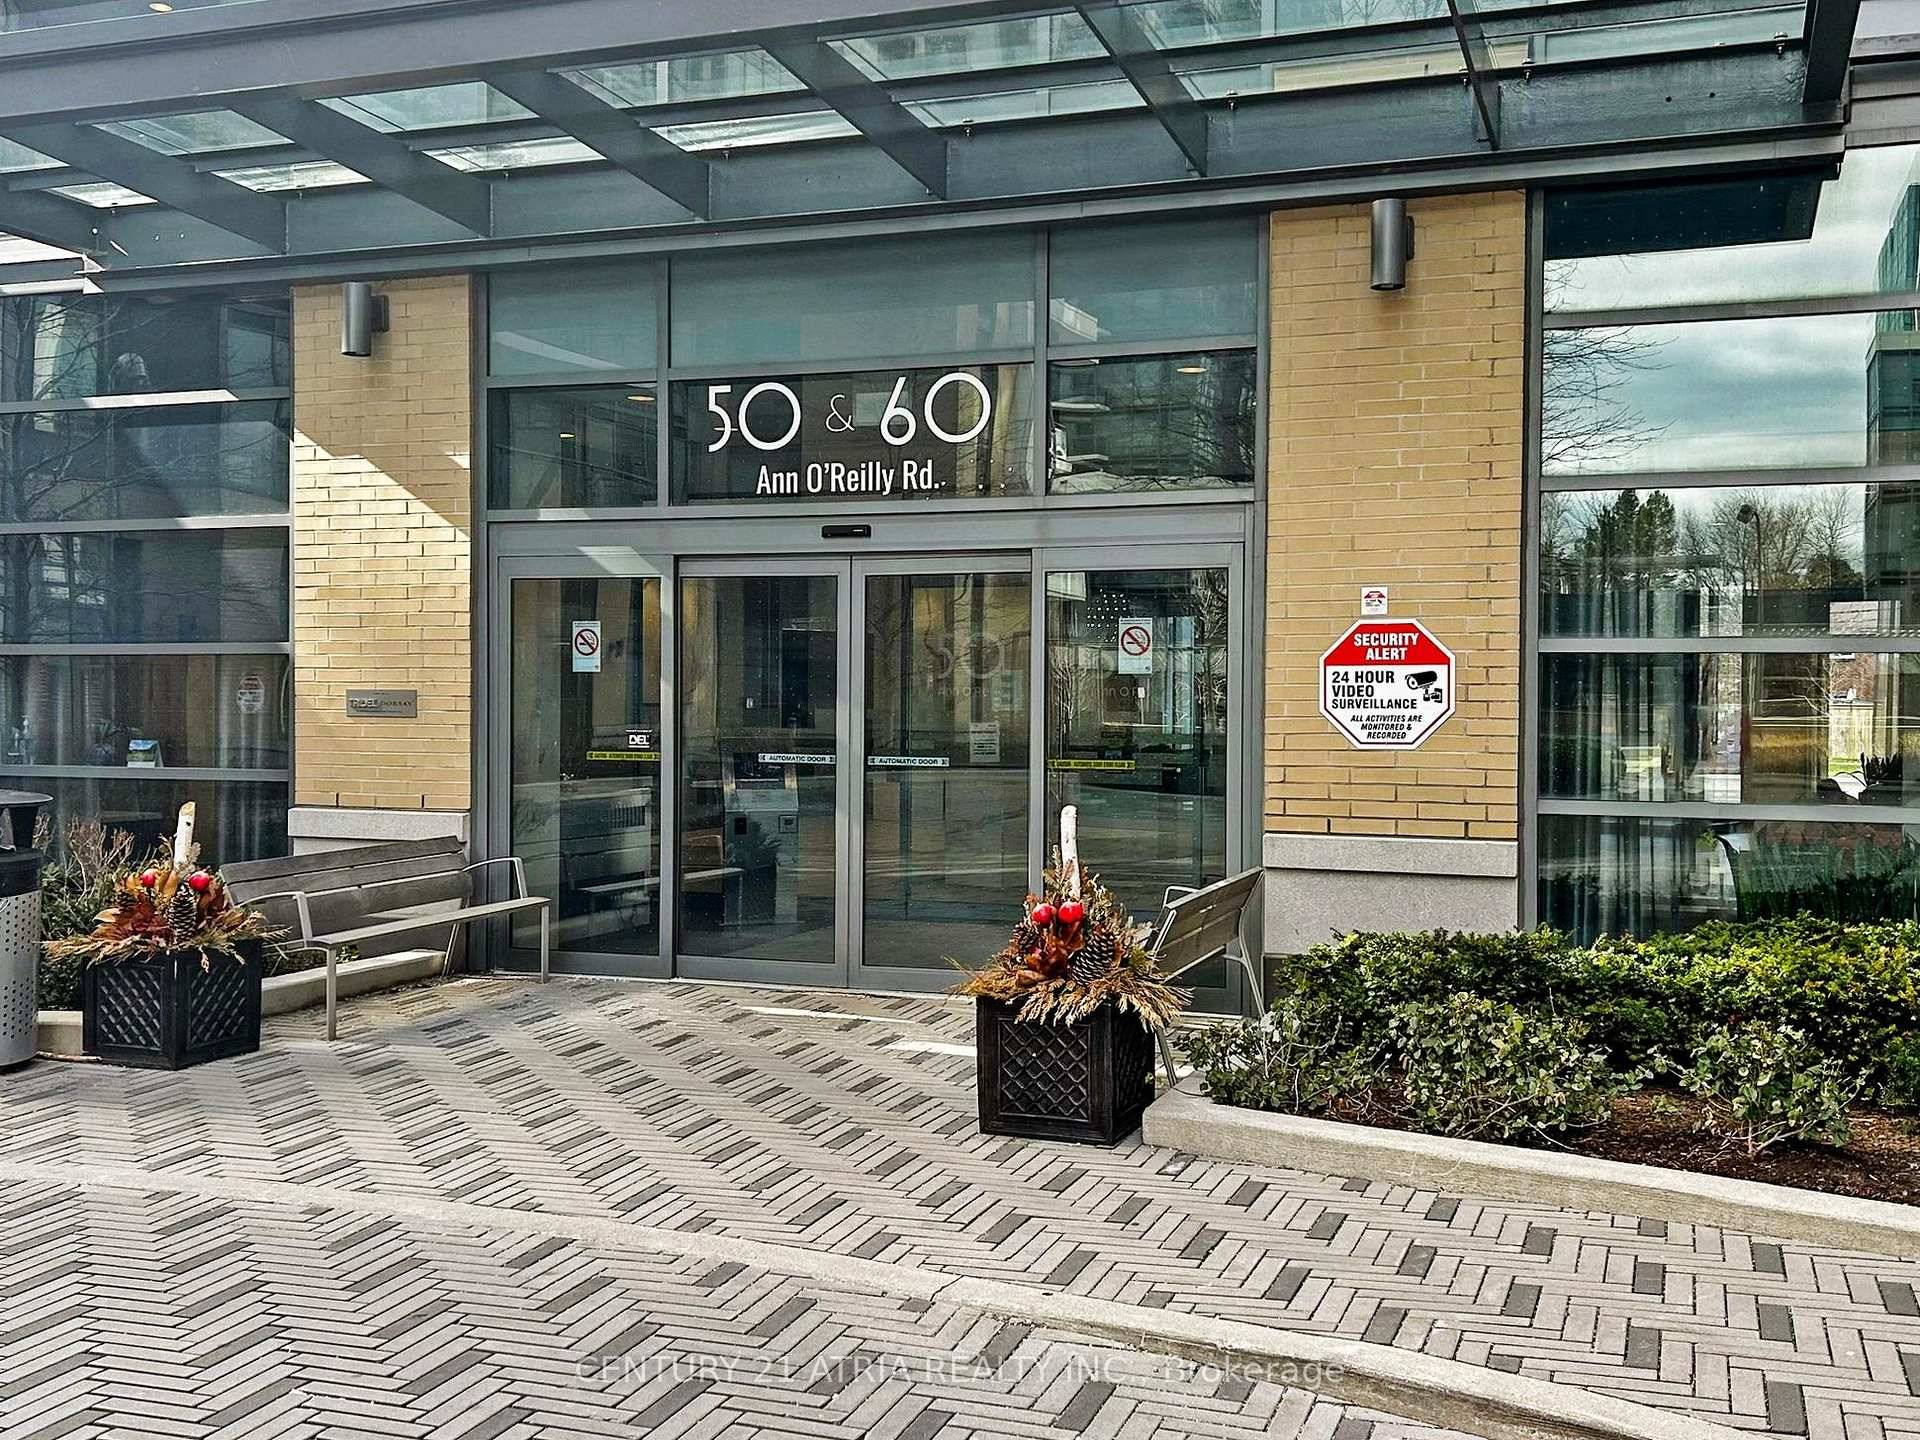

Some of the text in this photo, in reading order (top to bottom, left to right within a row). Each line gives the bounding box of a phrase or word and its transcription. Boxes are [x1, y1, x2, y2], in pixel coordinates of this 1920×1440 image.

[708, 372, 991, 452] 50 & 60
[756, 459, 939, 495] Ann O'Reilly Rd.
[1353, 632, 1420, 647] SECURITY
[1365, 647, 1408, 661] ALERT
[1331, 670, 1395, 684] 24 HOUR
[1332, 685, 1375, 698] VIDEO
[1331, 698, 1418, 710] SURVEILLANCE
[1350, 714, 1423, 723] ALL ACTIVITIES ARE
[1361, 723, 1412, 731] MONITORED &
[1367, 731, 1407, 740] RECORDED
[879, 757, 917, 765] AUTOMATIC
